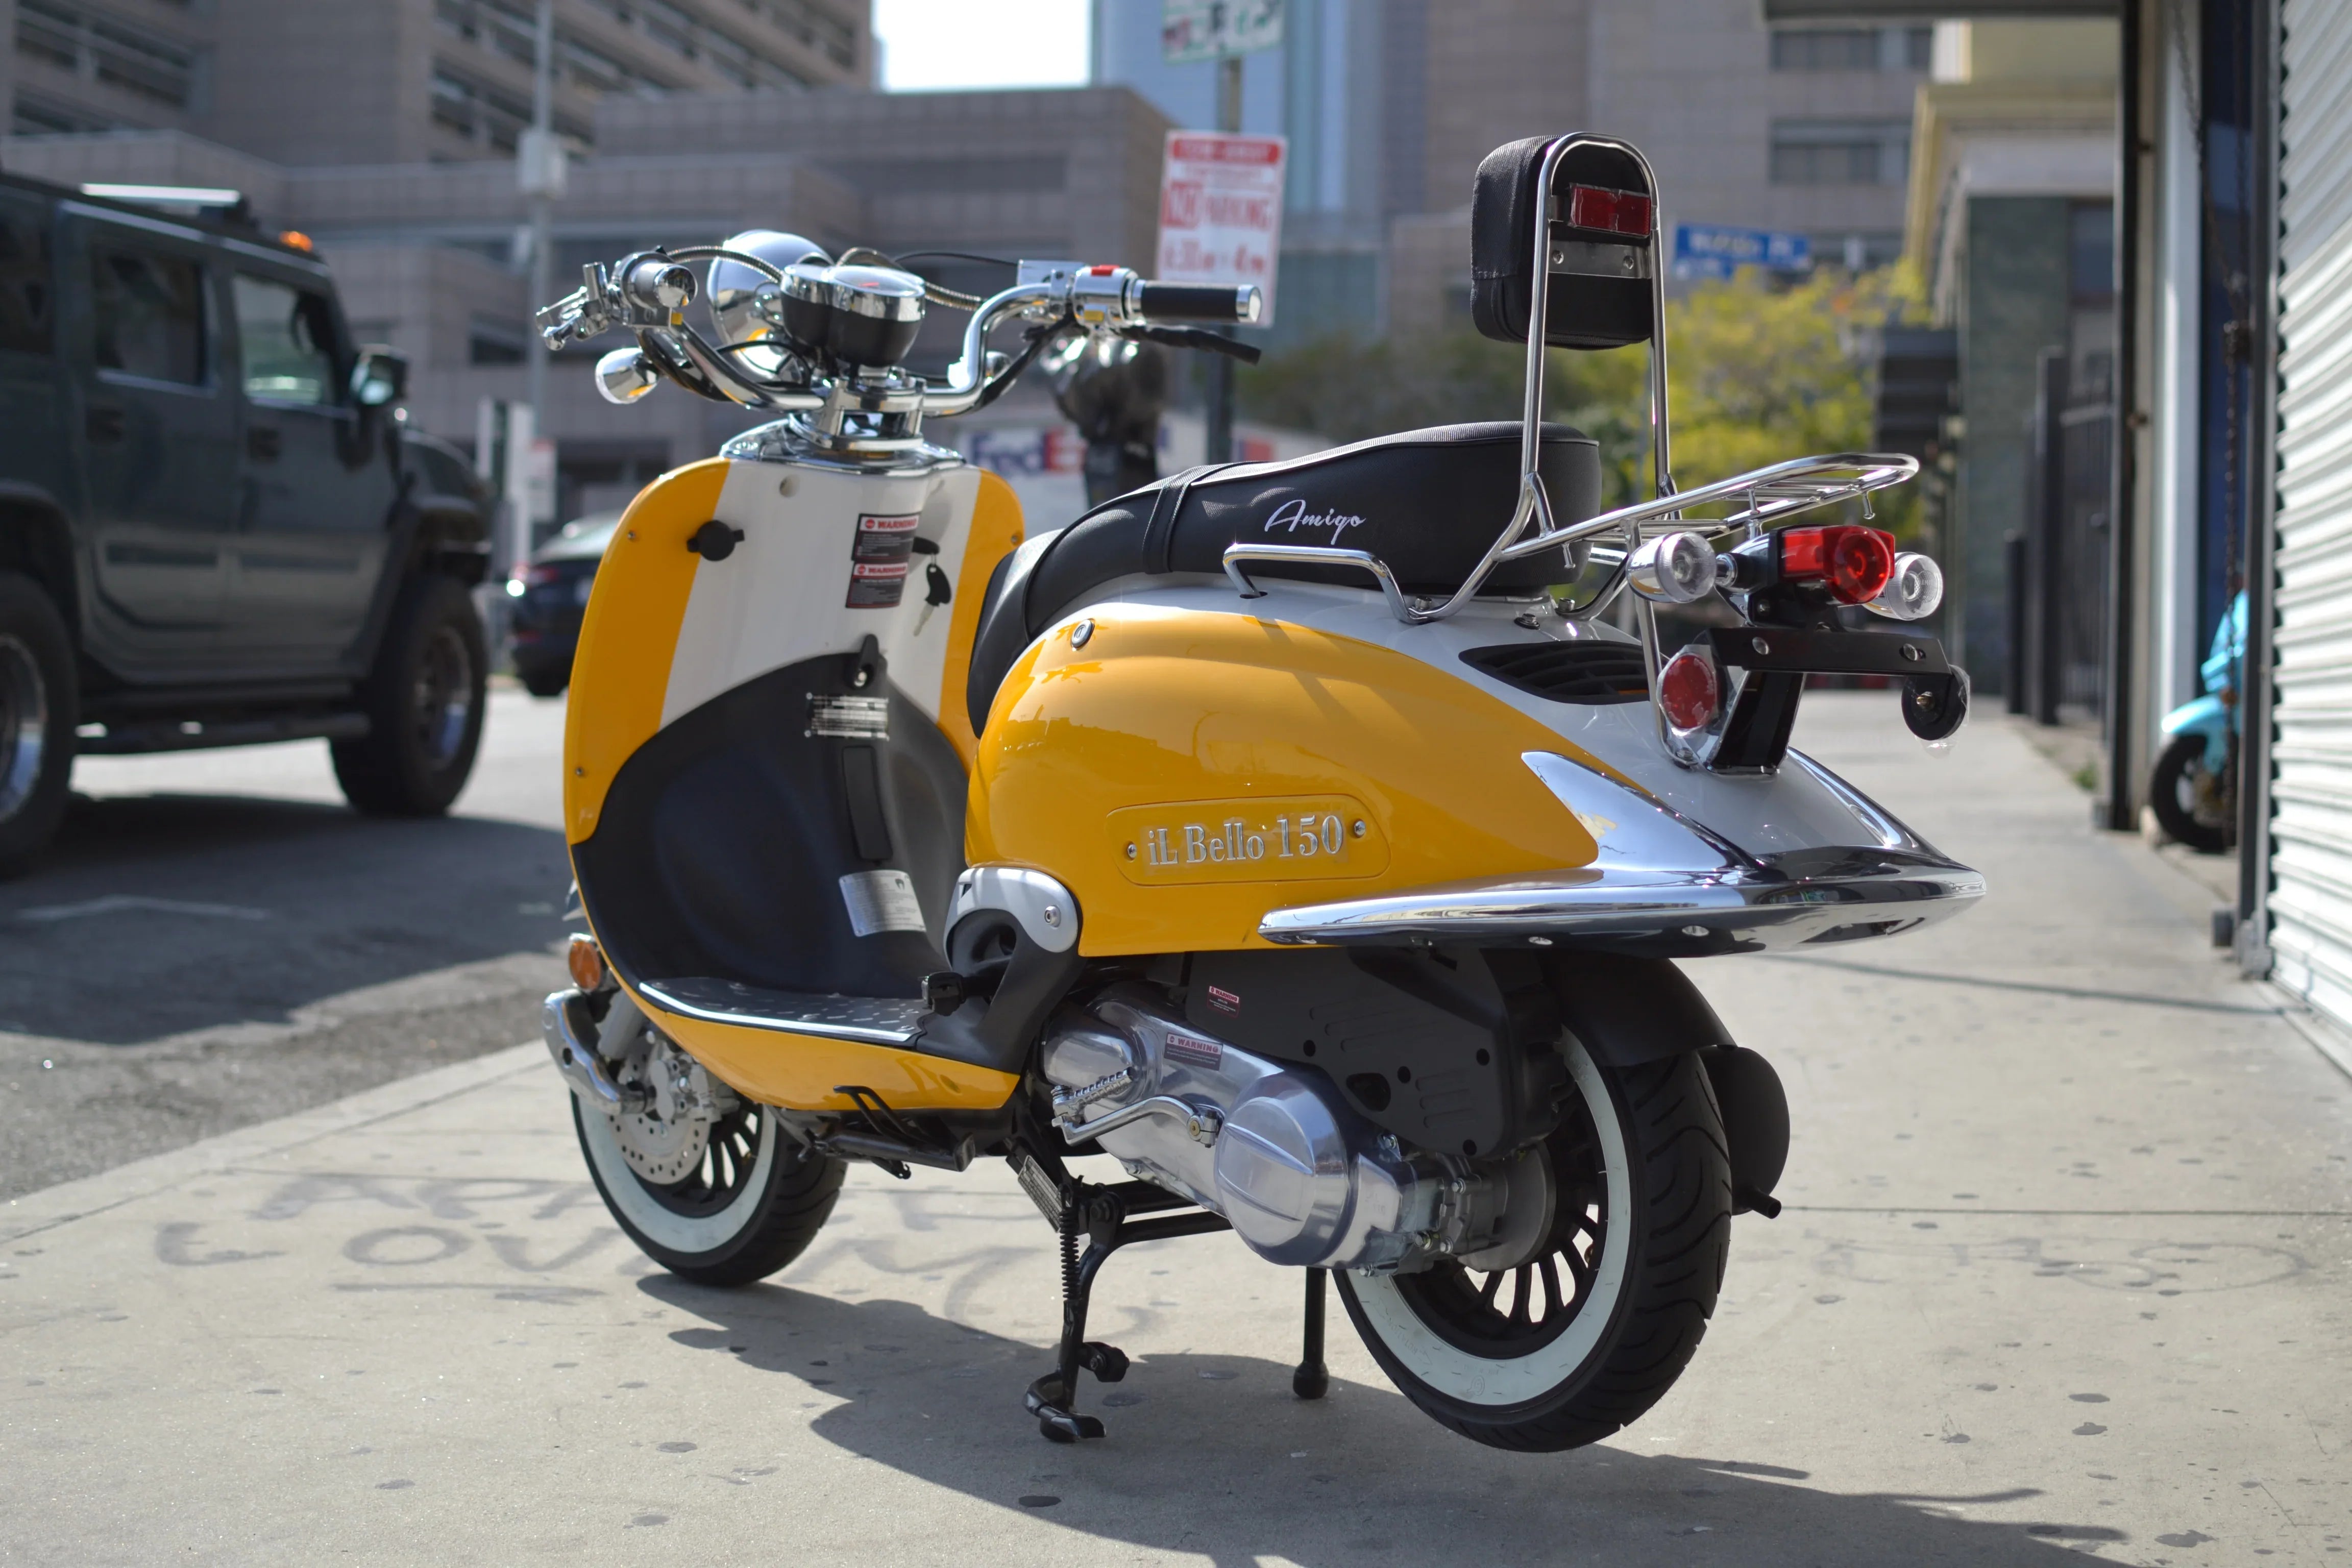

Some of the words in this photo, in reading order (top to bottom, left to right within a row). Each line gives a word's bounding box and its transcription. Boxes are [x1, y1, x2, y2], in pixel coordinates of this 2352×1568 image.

[877, 518, 917, 529] WARNING
[1264, 499, 1366, 546] Amigo
[868, 565, 906, 573] WARNING
[1148, 828, 1178, 865] iL
[1184, 823, 1264, 863] Bello
[1277, 815, 1343, 857] 150
[1215, 988, 1238, 1002] WARNING
[1178, 1038, 1219, 1054] WARNING
